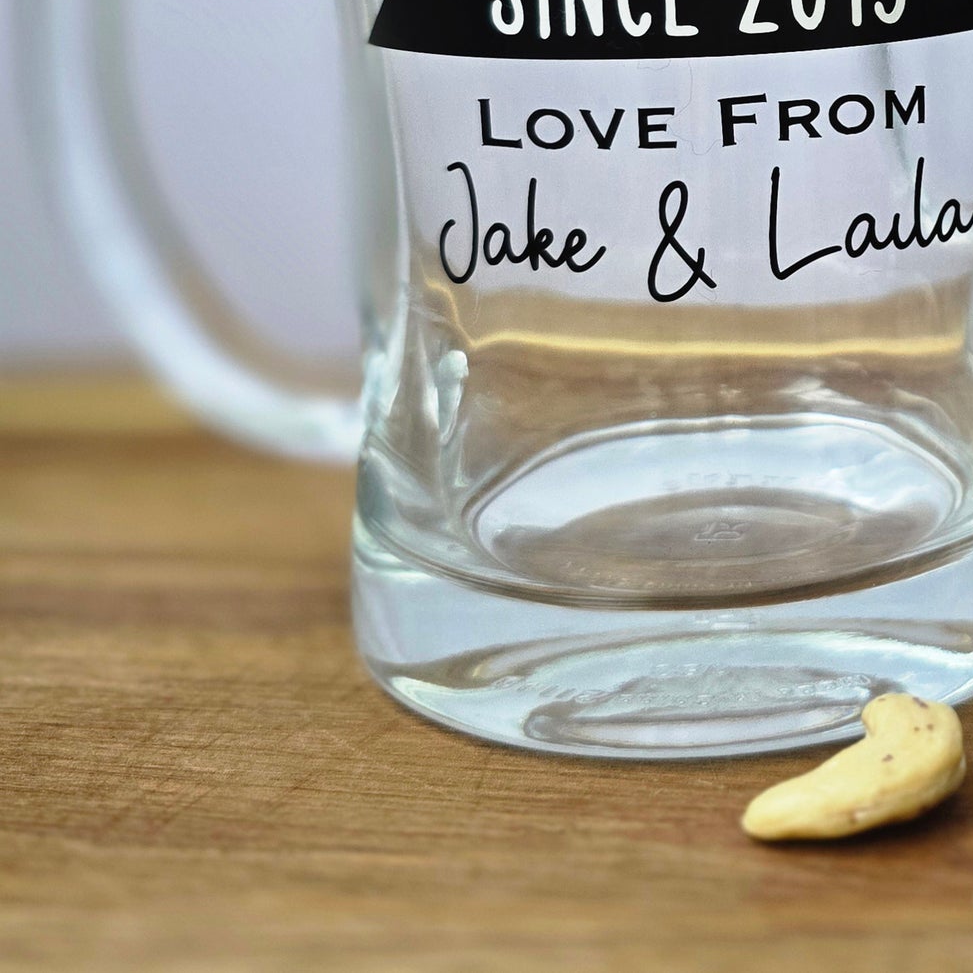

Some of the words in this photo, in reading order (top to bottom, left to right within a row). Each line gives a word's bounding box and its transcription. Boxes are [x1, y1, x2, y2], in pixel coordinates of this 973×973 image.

[477, 98, 678, 150] LOVE
[717, 85, 926, 148] FROM
[439, 161, 607, 285] Jake
[647, 180, 718, 303] &
